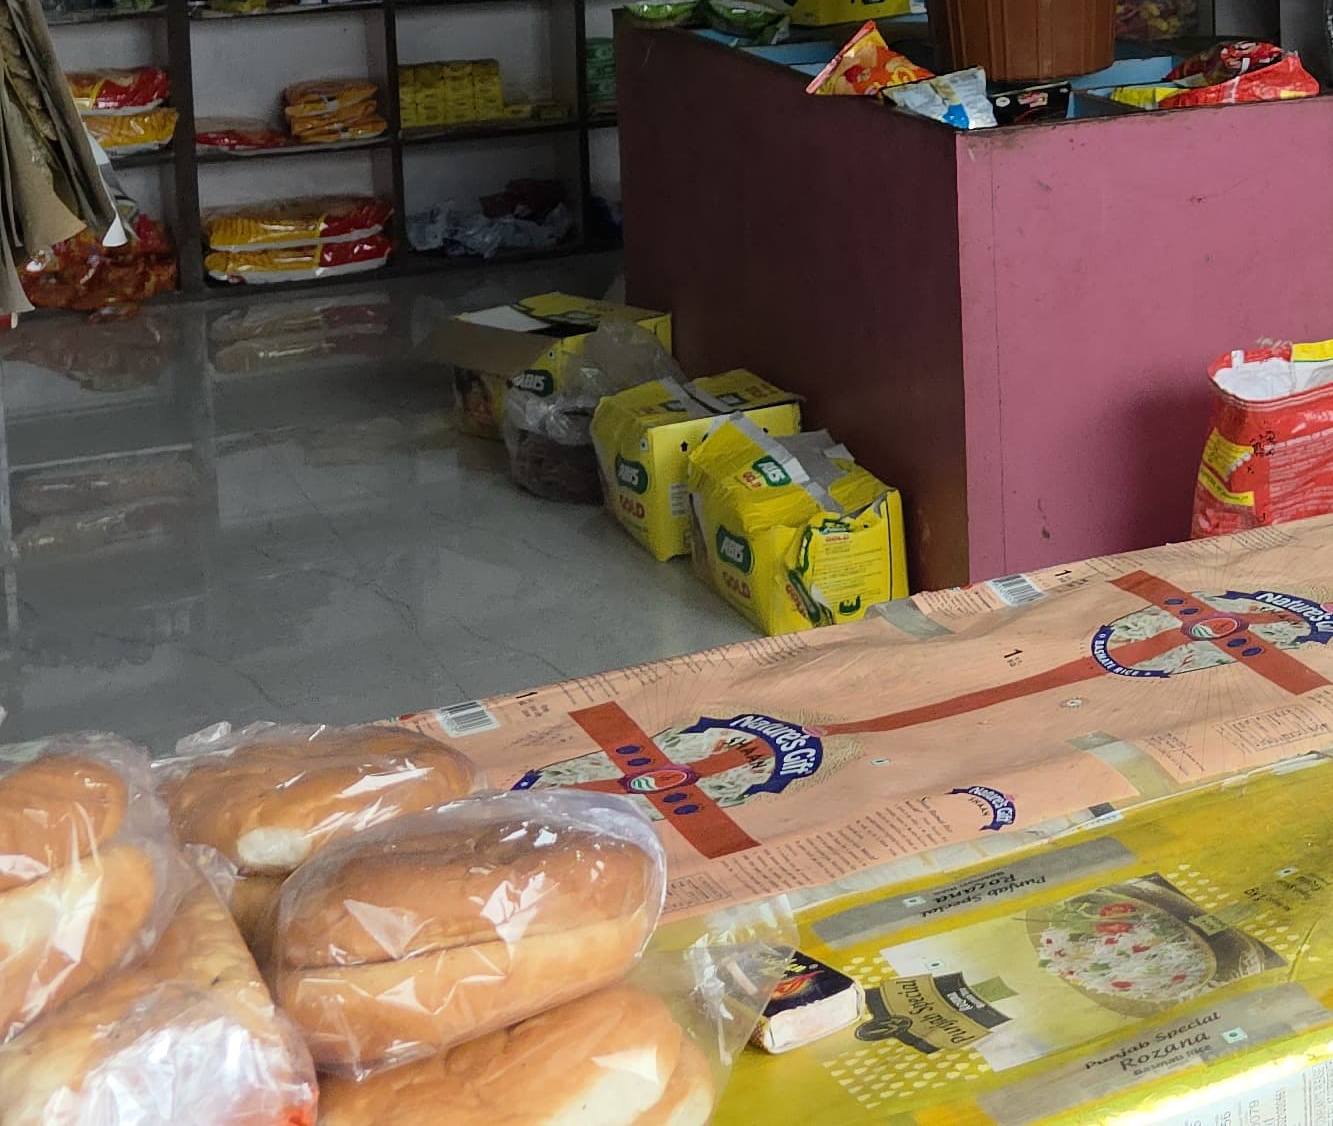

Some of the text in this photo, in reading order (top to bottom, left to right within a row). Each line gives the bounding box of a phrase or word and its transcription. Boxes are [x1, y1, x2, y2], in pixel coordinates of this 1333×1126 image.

[616, 462, 641, 489] ABIS
[721, 533, 747, 564] ABIS
[722, 572, 752, 599] GOLD
[729, 715, 817, 776] Nature's Gift
[920, 874, 1047, 918] Punjab Special
[895, 977, 933, 1016] Special
[922, 1008, 977, 1044] Punjab
[1084, 1011, 1222, 1070] Punjab Special
[1120, 1030, 1211, 1071] Rozana
